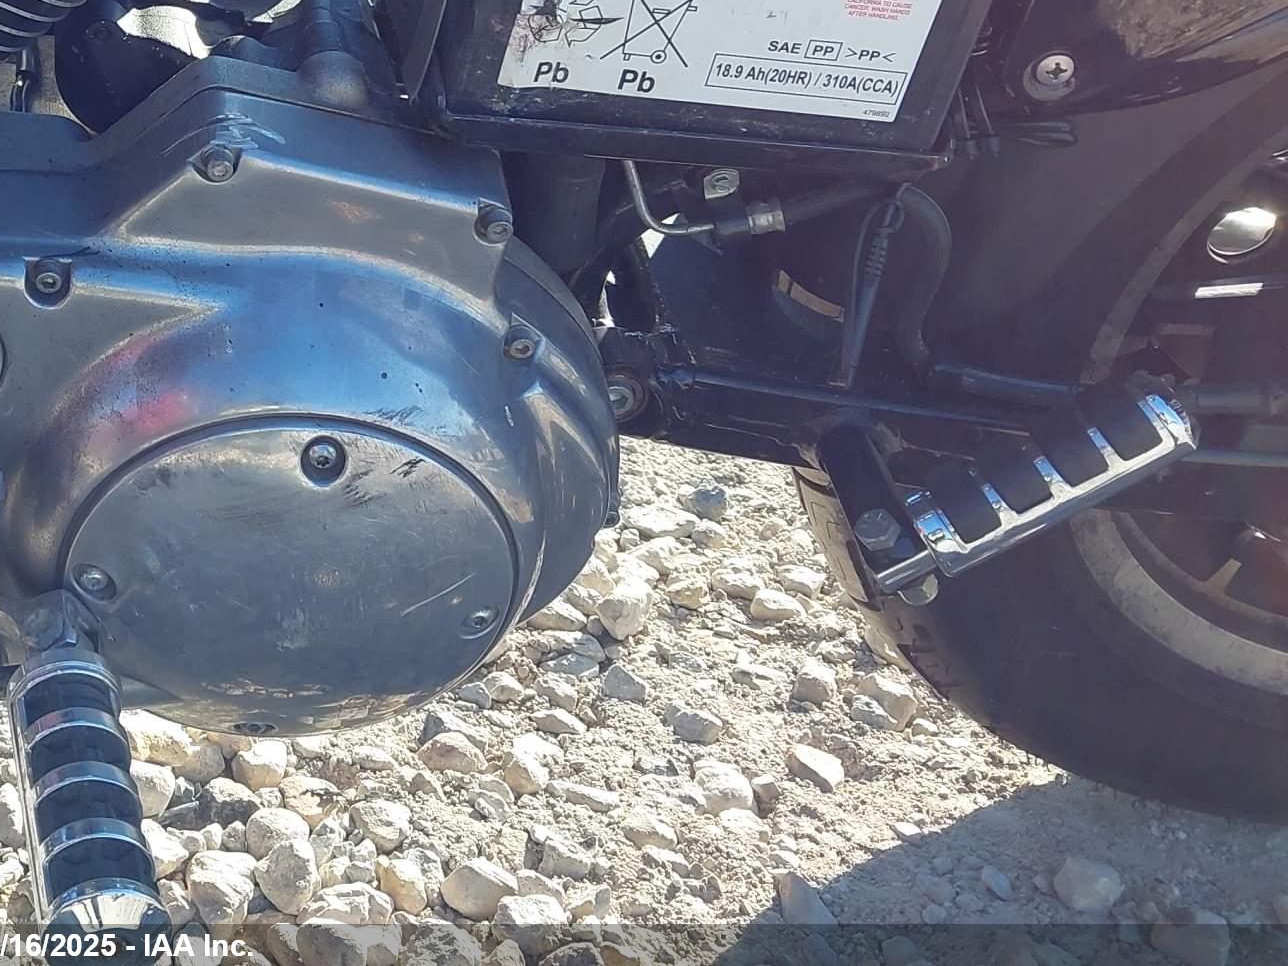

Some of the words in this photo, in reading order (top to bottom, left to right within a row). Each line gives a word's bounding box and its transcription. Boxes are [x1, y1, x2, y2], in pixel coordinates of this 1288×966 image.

[768, 41, 802, 54] SAE
[811, 45, 835, 57] PP
[533, 61, 569, 83] Pb
[617, 69, 656, 93] Pb
[715, 63, 744, 79] 18.9
[745, 66, 812, 89] Ah(20HR)
[823, 74, 899, 97] 310A(CCA)
